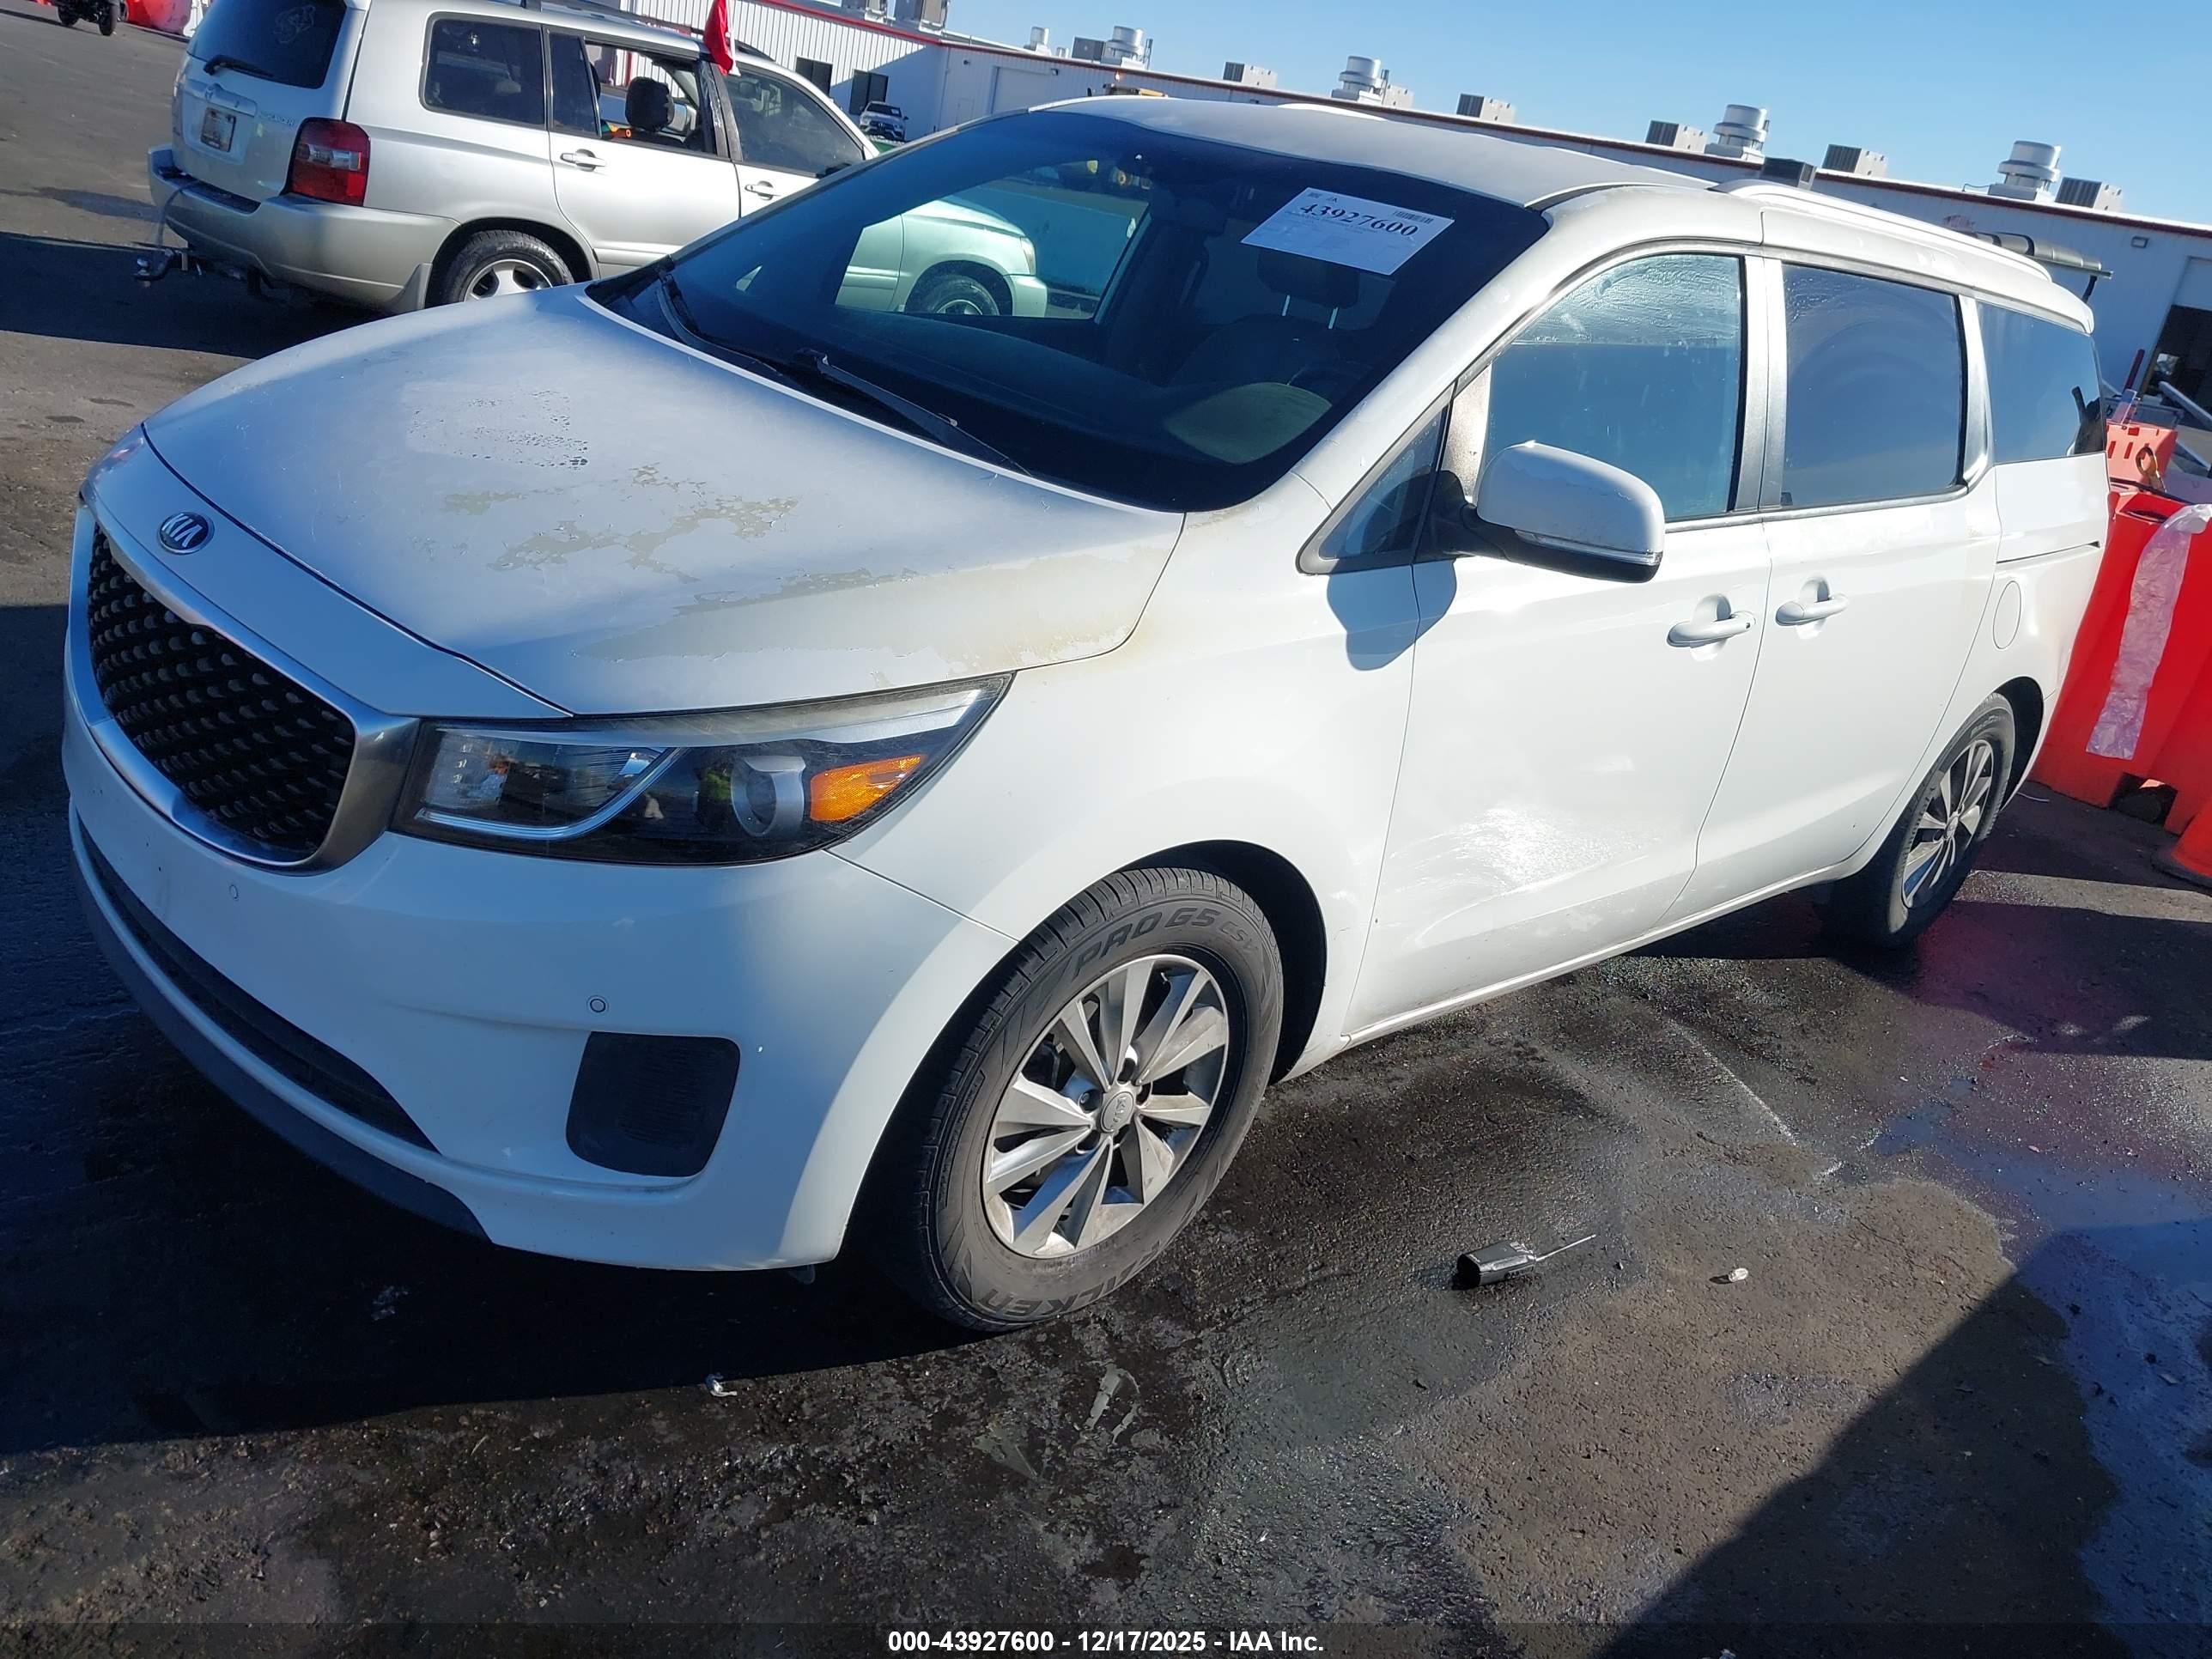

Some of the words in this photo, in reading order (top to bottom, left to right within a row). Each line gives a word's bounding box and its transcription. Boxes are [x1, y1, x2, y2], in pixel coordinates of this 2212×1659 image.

[1299, 204, 1419, 236] 43927600
[161, 513, 203, 548] KIA
[1073, 912, 1162, 979] PRO
